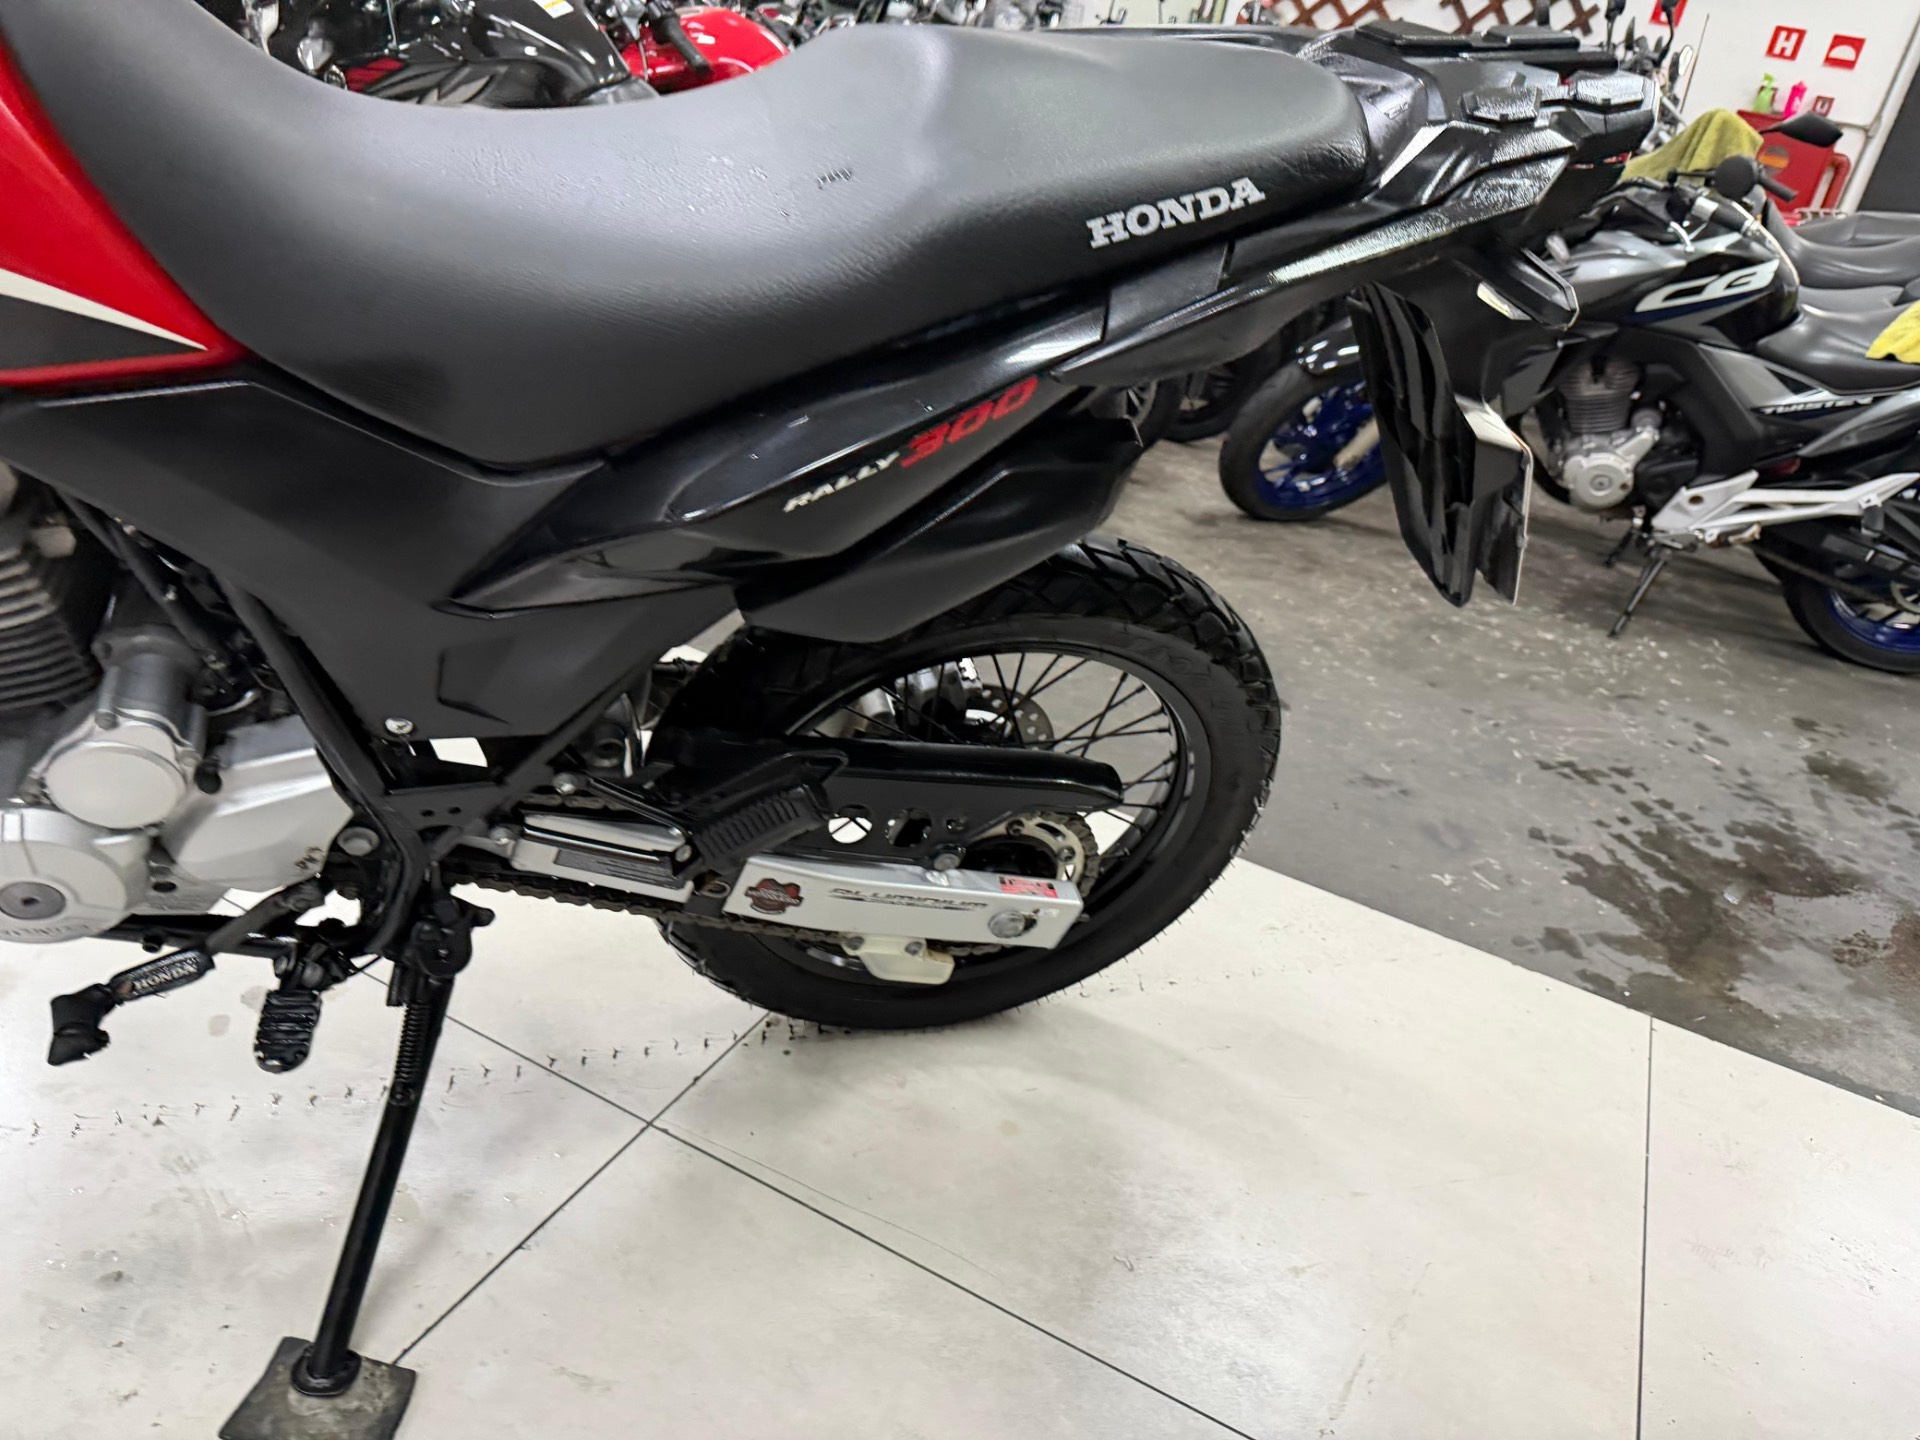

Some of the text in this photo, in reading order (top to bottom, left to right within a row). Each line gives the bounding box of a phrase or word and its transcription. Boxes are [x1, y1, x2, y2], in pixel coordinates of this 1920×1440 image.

[1773, 30, 1800, 57] H
[1086, 177, 1266, 249] HONDA
[1634, 258, 1780, 313] CB
[783, 376, 1039, 512] RALLY 300
